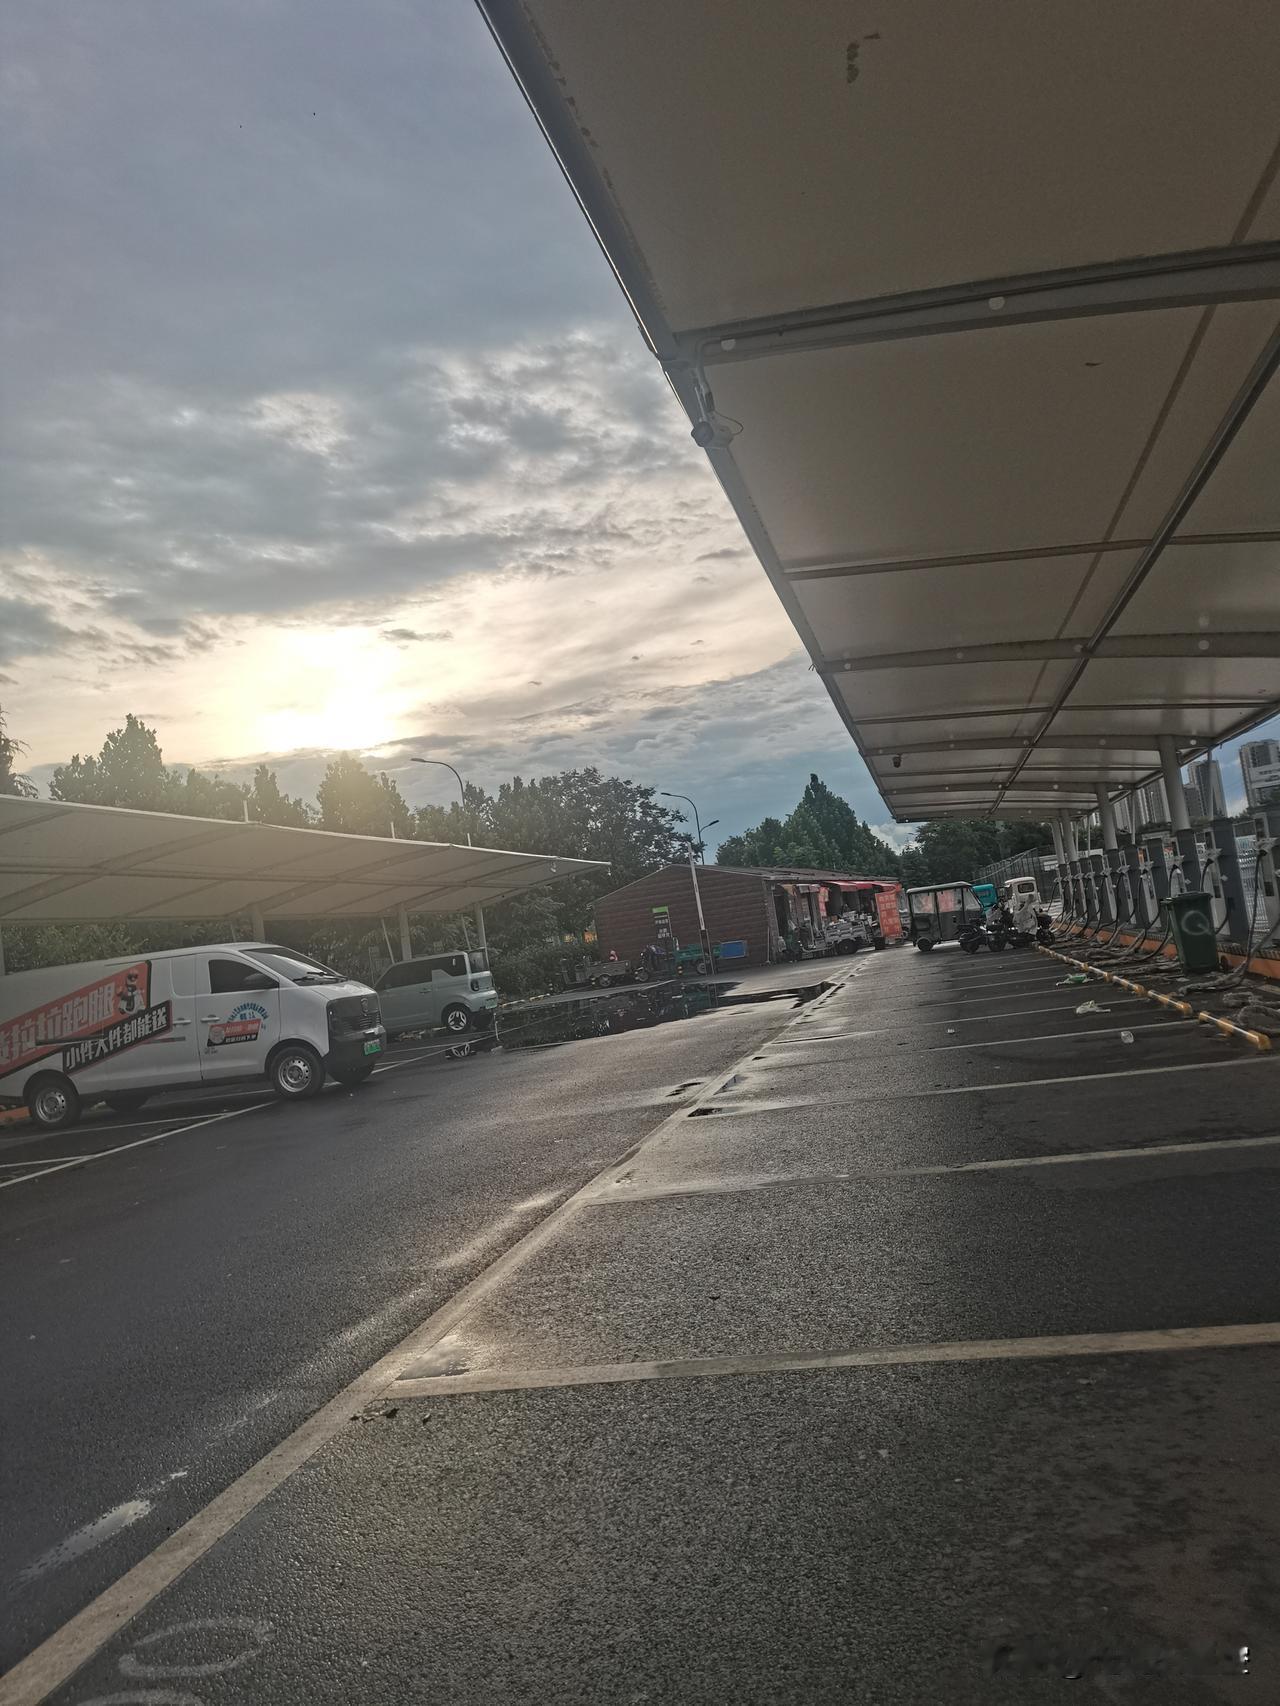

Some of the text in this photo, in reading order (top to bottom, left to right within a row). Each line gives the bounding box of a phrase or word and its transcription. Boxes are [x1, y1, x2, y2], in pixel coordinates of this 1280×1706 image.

[65, 1006, 168, 1070] 小件大件都能送
